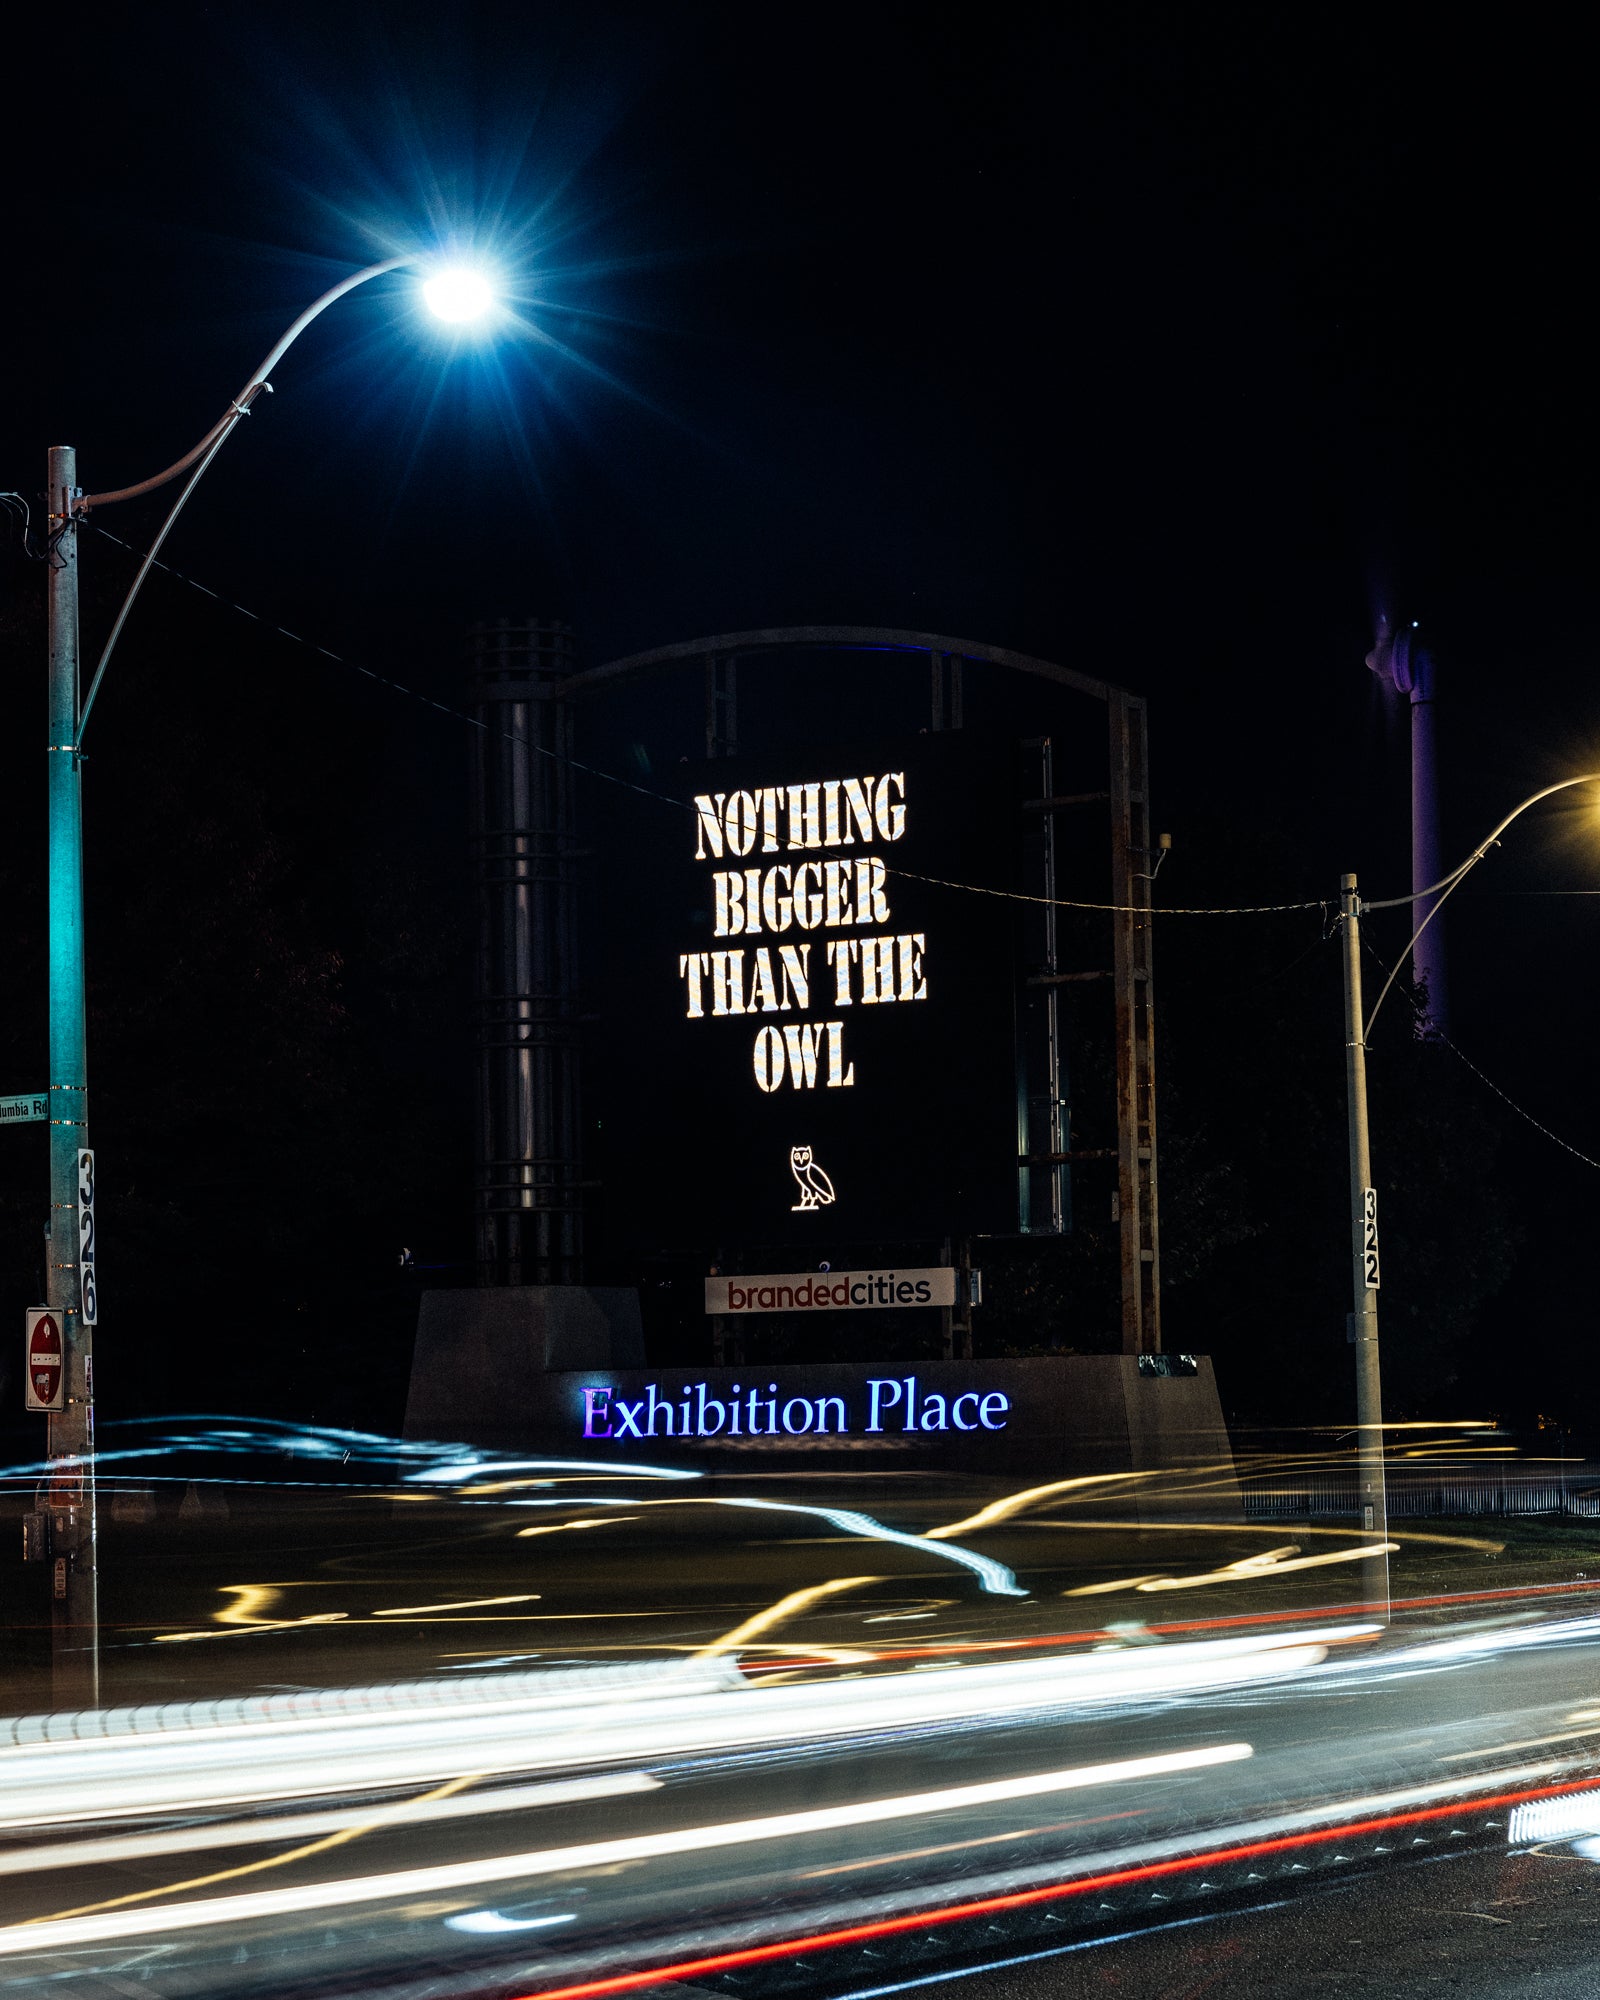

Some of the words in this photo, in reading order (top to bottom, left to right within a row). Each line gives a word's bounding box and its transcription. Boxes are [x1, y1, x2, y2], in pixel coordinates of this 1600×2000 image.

[694, 772, 906, 860] NOTHING
[713, 857, 890, 937] BIGGER
[679, 944, 811, 1018] THAN
[827, 933, 927, 1006] THE
[753, 1021, 854, 1093] OWL
[33, 1100, 48, 1115] Rd
[80, 1153, 96, 1321] 326
[1366, 1191, 1378, 1284] 322
[728, 1273, 931, 1310] brandedcities
[580, 1382, 849, 1439] Exhibition
[864, 1376, 1010, 1432] Place
